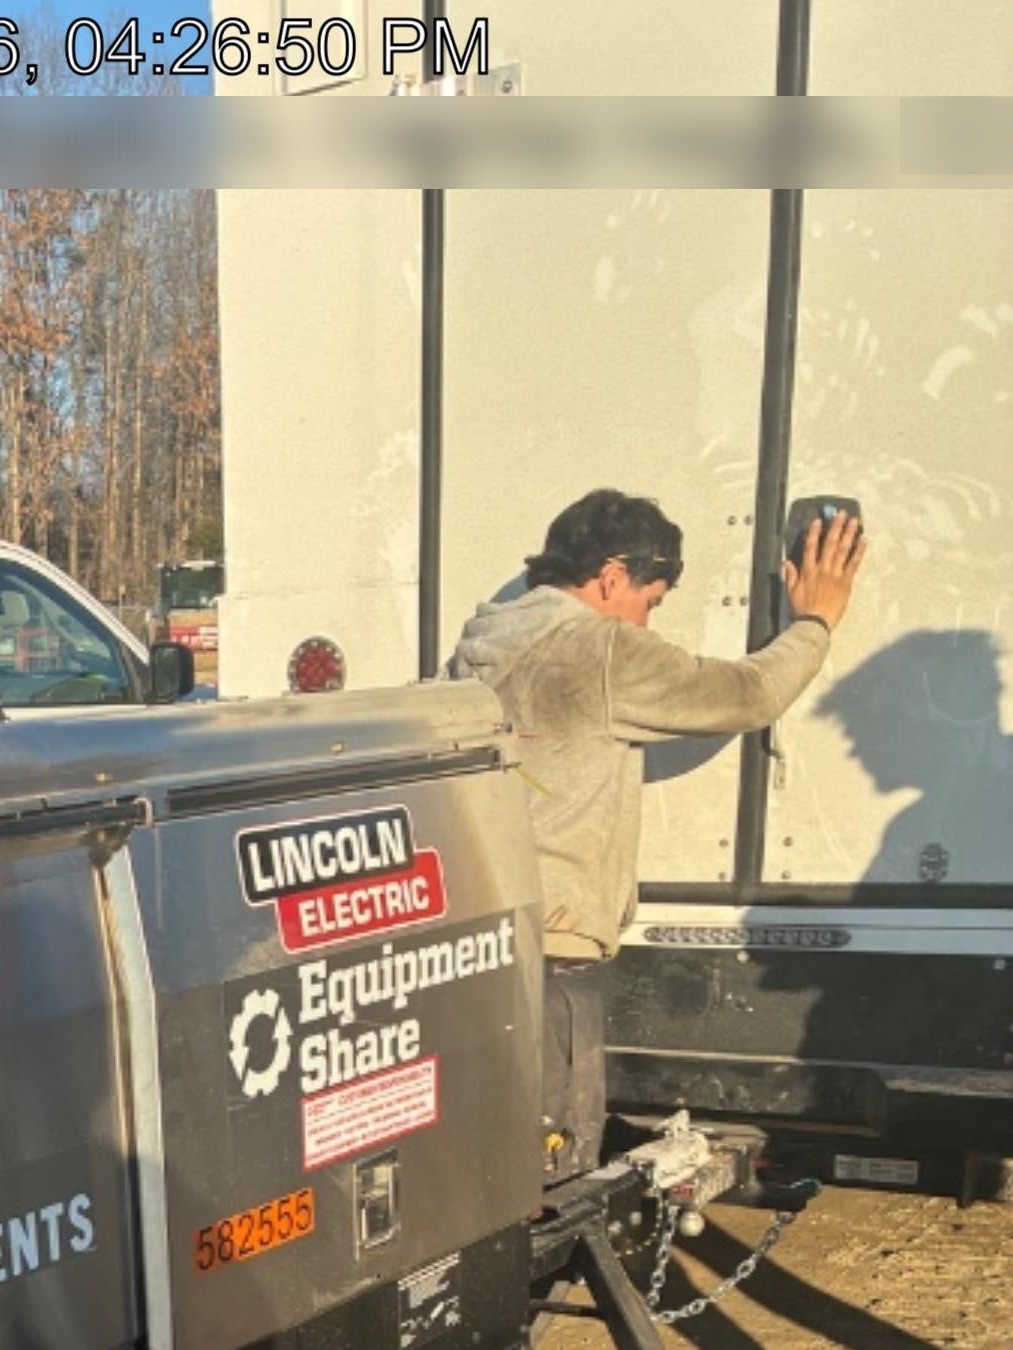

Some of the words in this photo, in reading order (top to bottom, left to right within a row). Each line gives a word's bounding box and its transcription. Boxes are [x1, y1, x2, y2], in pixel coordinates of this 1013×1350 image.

[248, 818, 407, 892] LINCOLN
[298, 875, 430, 937] ELECTRIC
[299, 917, 514, 1026] Equipment
[301, 1018, 420, 1094] Share
[197, 1189, 314, 1271] 582555
